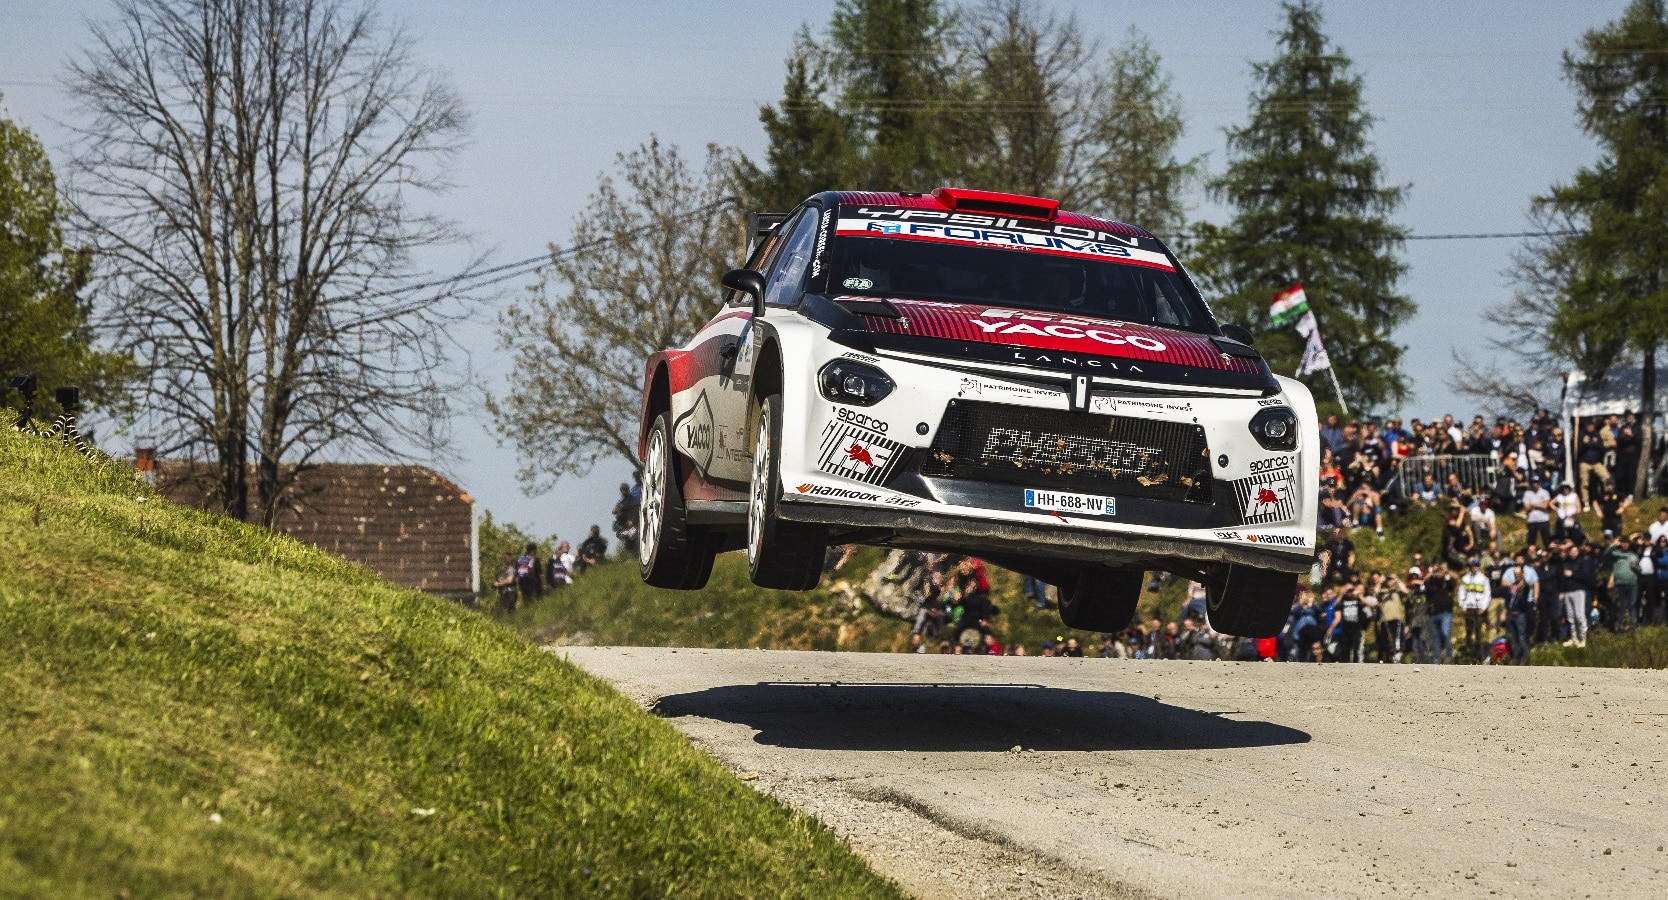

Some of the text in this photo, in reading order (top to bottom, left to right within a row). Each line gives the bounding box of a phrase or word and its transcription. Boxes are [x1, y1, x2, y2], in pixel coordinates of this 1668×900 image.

[857, 207, 1139, 247] YPSILON
[909, 223, 1132, 257] FORUM8
[970, 319, 1167, 352] YACCO
[1014, 352, 1144, 373] LANCIA
[983, 384, 1031, 394] PATRIMOINE
[1117, 399, 1164, 409] PATRIMOINE
[838, 407, 889, 432] sparco
[686, 423, 711, 450] YACCO
[1249, 456, 1289, 474] sparco
[1037, 492, 1103, 511] HH-688-NV
